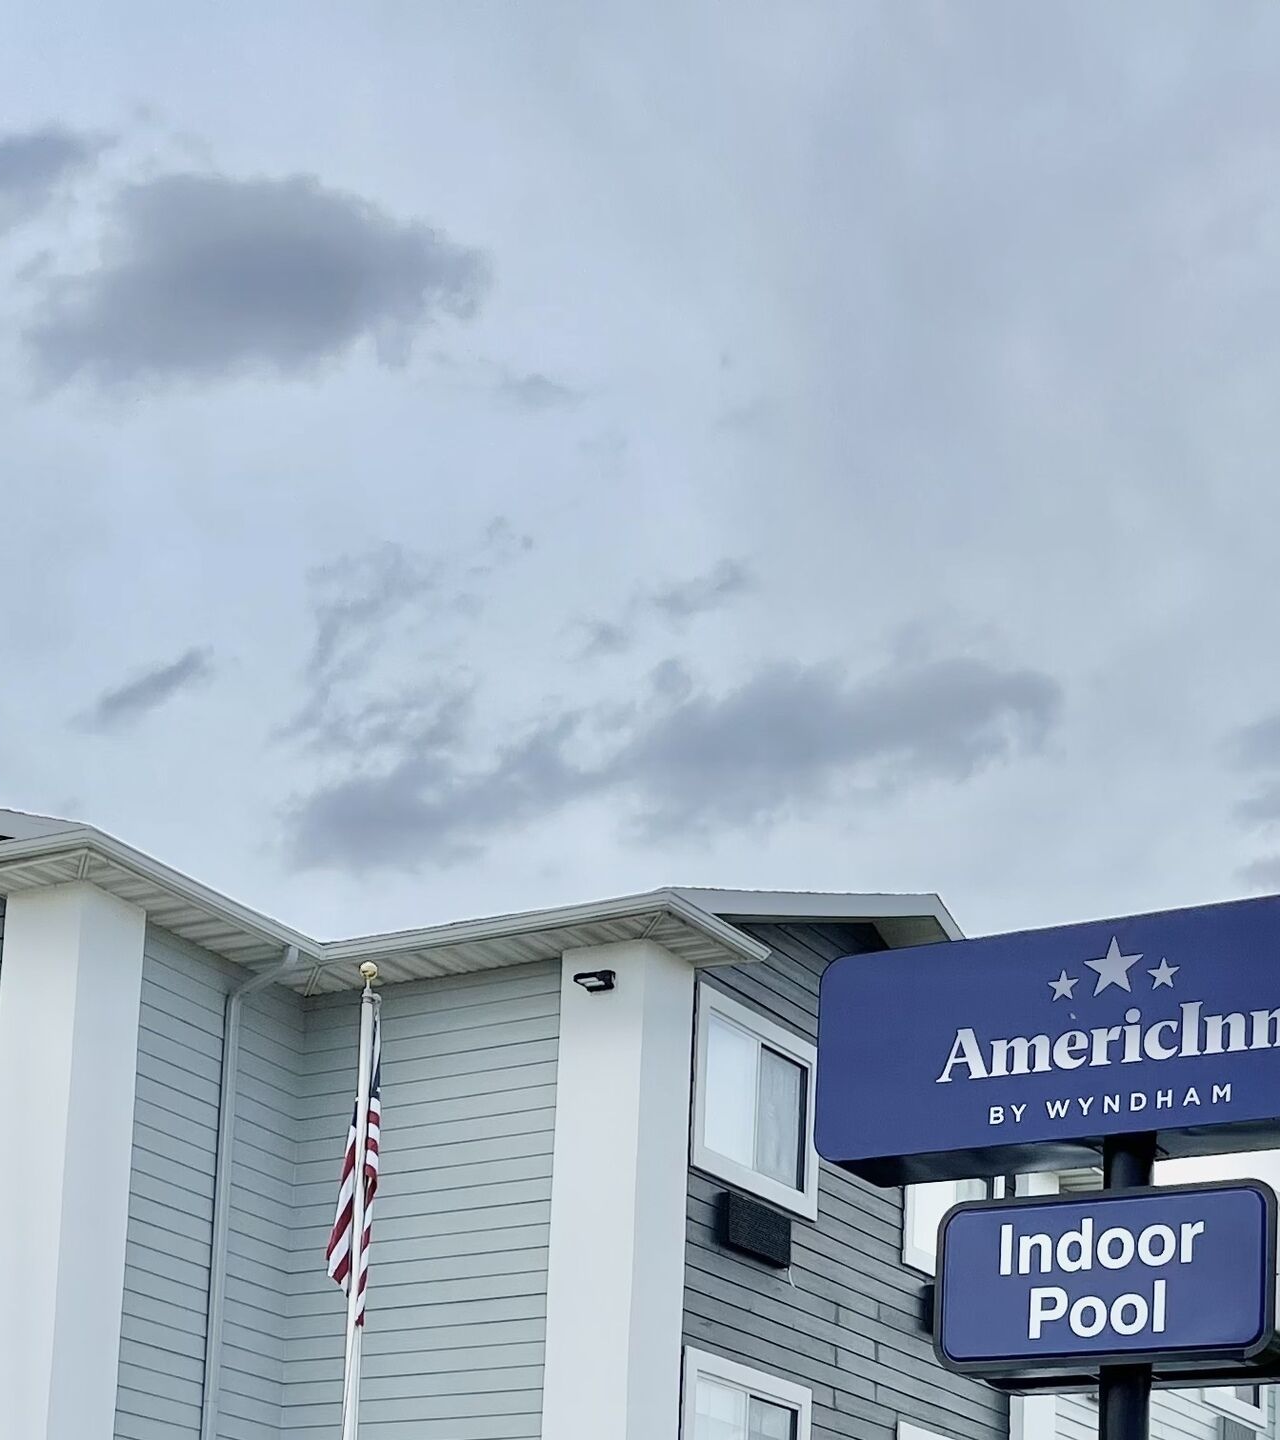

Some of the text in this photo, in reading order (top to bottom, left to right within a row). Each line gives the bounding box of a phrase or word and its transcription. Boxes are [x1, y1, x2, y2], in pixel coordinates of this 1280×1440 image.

[988, 1083, 1233, 1126] BY WYNDHAM
[999, 1218, 1204, 1276] Indoor
[1027, 1279, 1166, 1339] Pool
